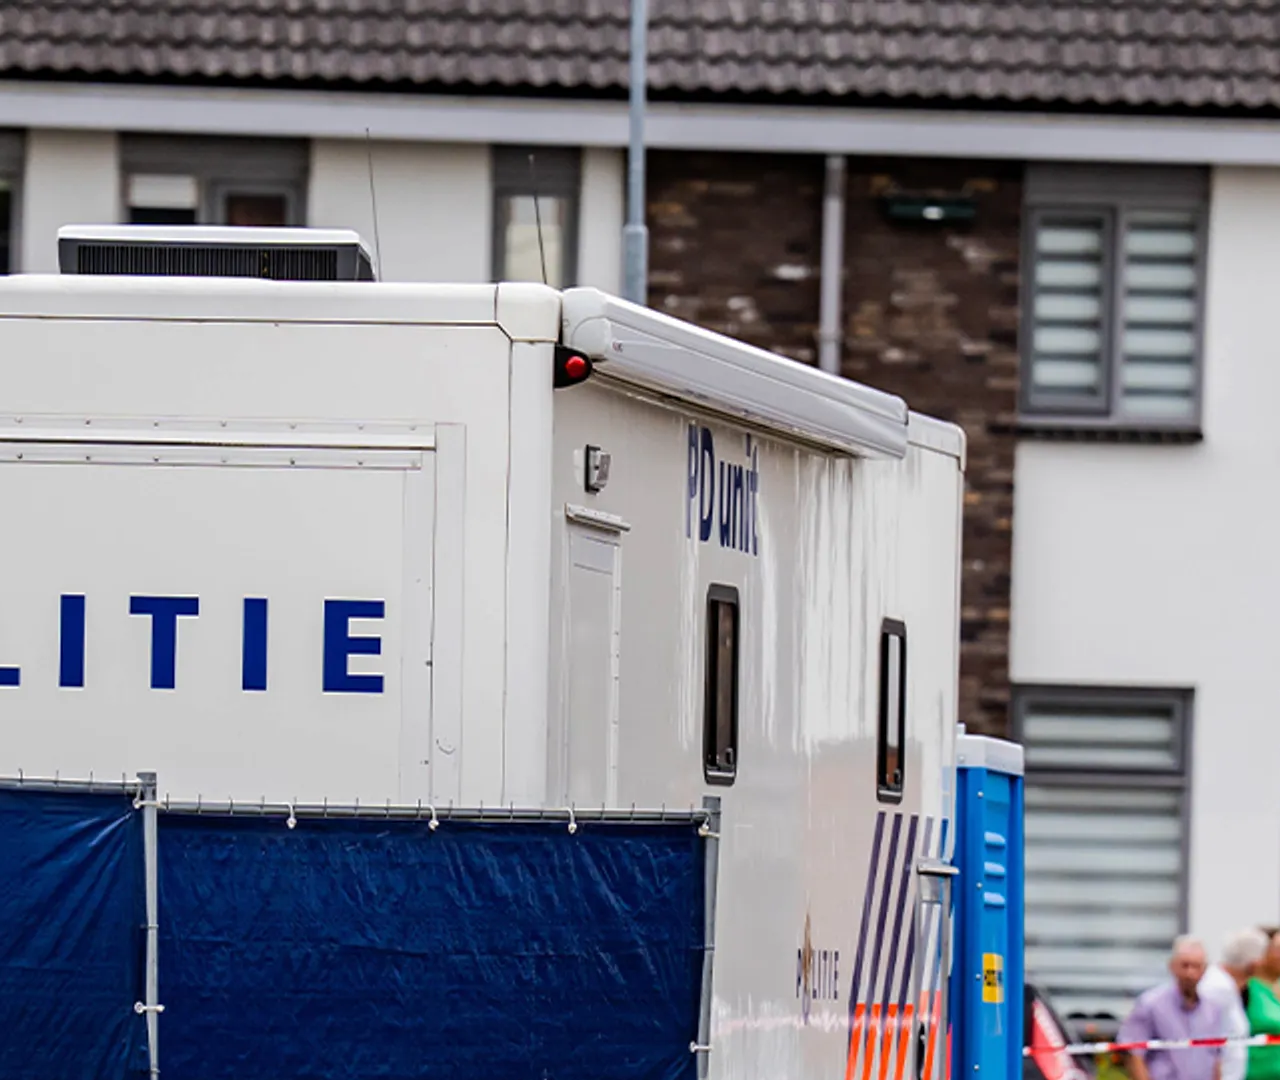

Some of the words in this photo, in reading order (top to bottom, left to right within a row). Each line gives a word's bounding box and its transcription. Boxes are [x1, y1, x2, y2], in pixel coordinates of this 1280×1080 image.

[686, 423, 715, 542] PD
[719, 431, 758, 557] unit
[795, 947, 839, 1026] POLITIE
